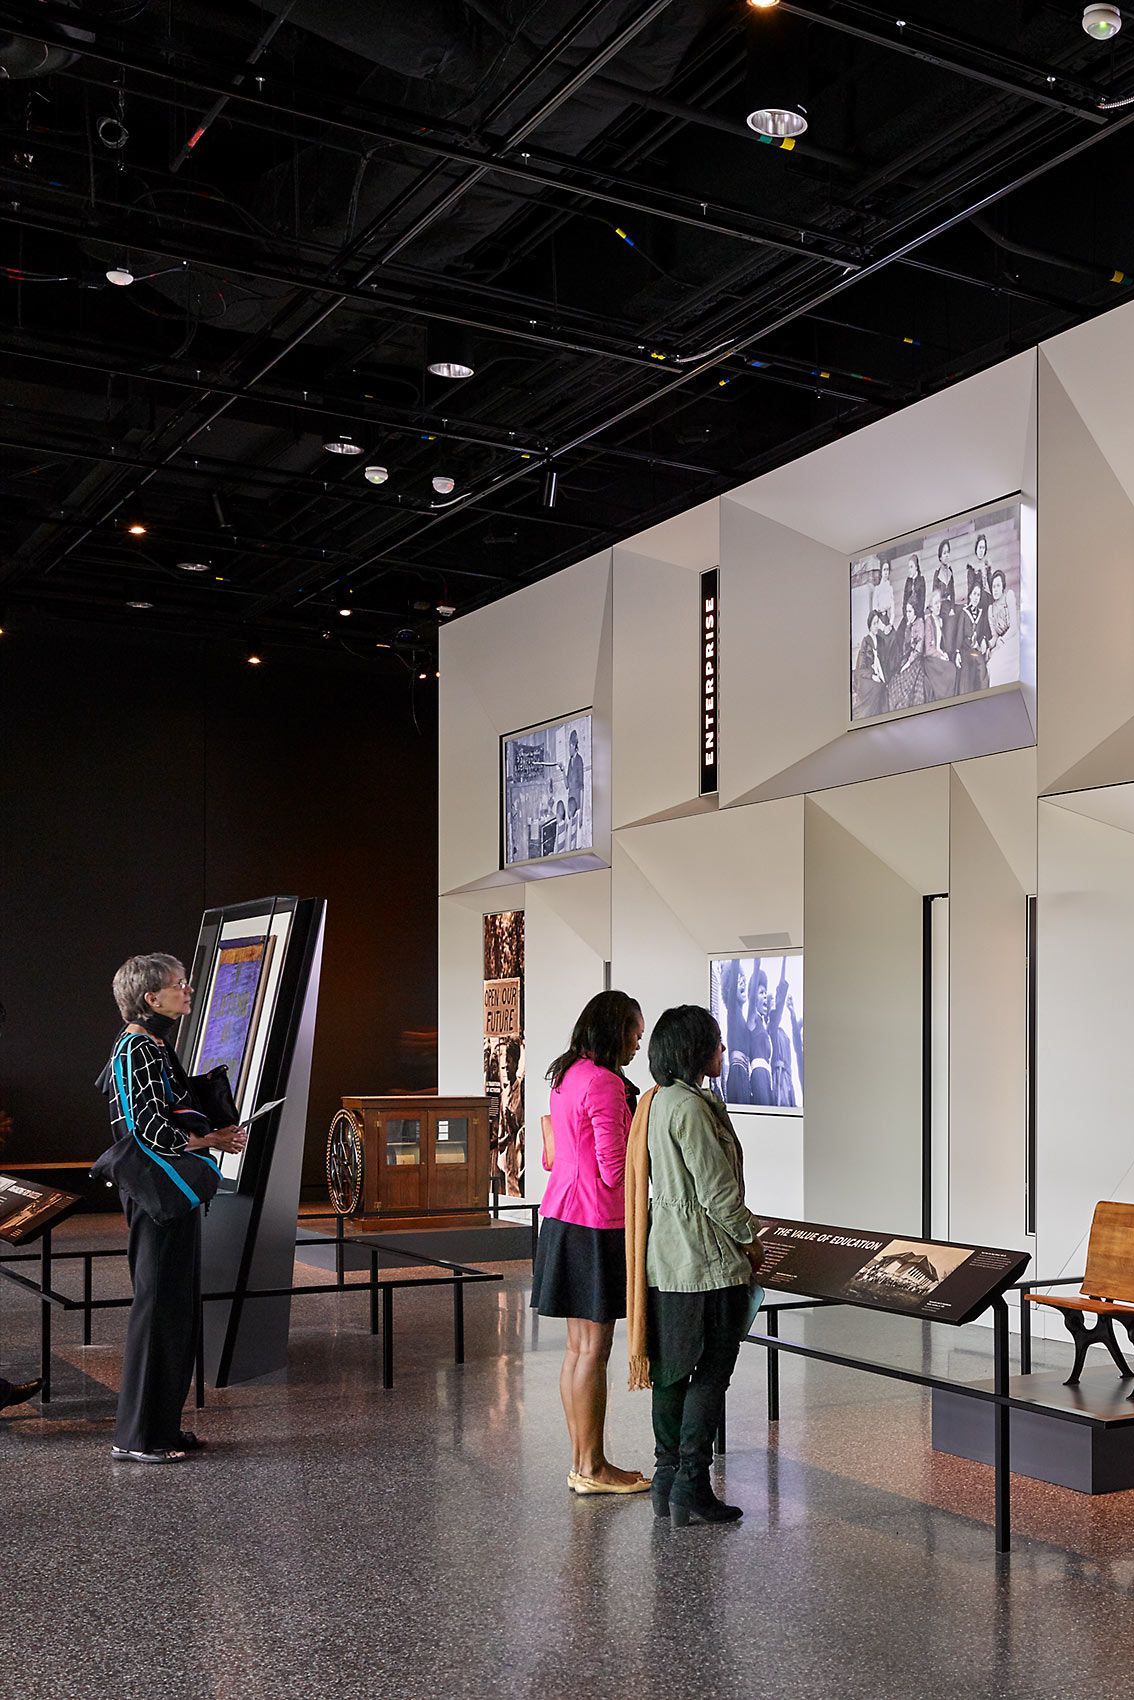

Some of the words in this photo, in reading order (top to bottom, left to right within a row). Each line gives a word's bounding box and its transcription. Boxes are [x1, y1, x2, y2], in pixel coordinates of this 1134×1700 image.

[705, 597, 714, 766] ENTERPRISE
[485, 988, 499, 1007] OPEN
[502, 987, 517, 1006] OUR
[486, 1009, 515, 1032] FUTURE
[774, 1228, 793, 1236] THE
[791, 1228, 819, 1241] VALUE
[817, 1234, 833, 1242] OF
[829, 1236, 883, 1251] EDUCATION
